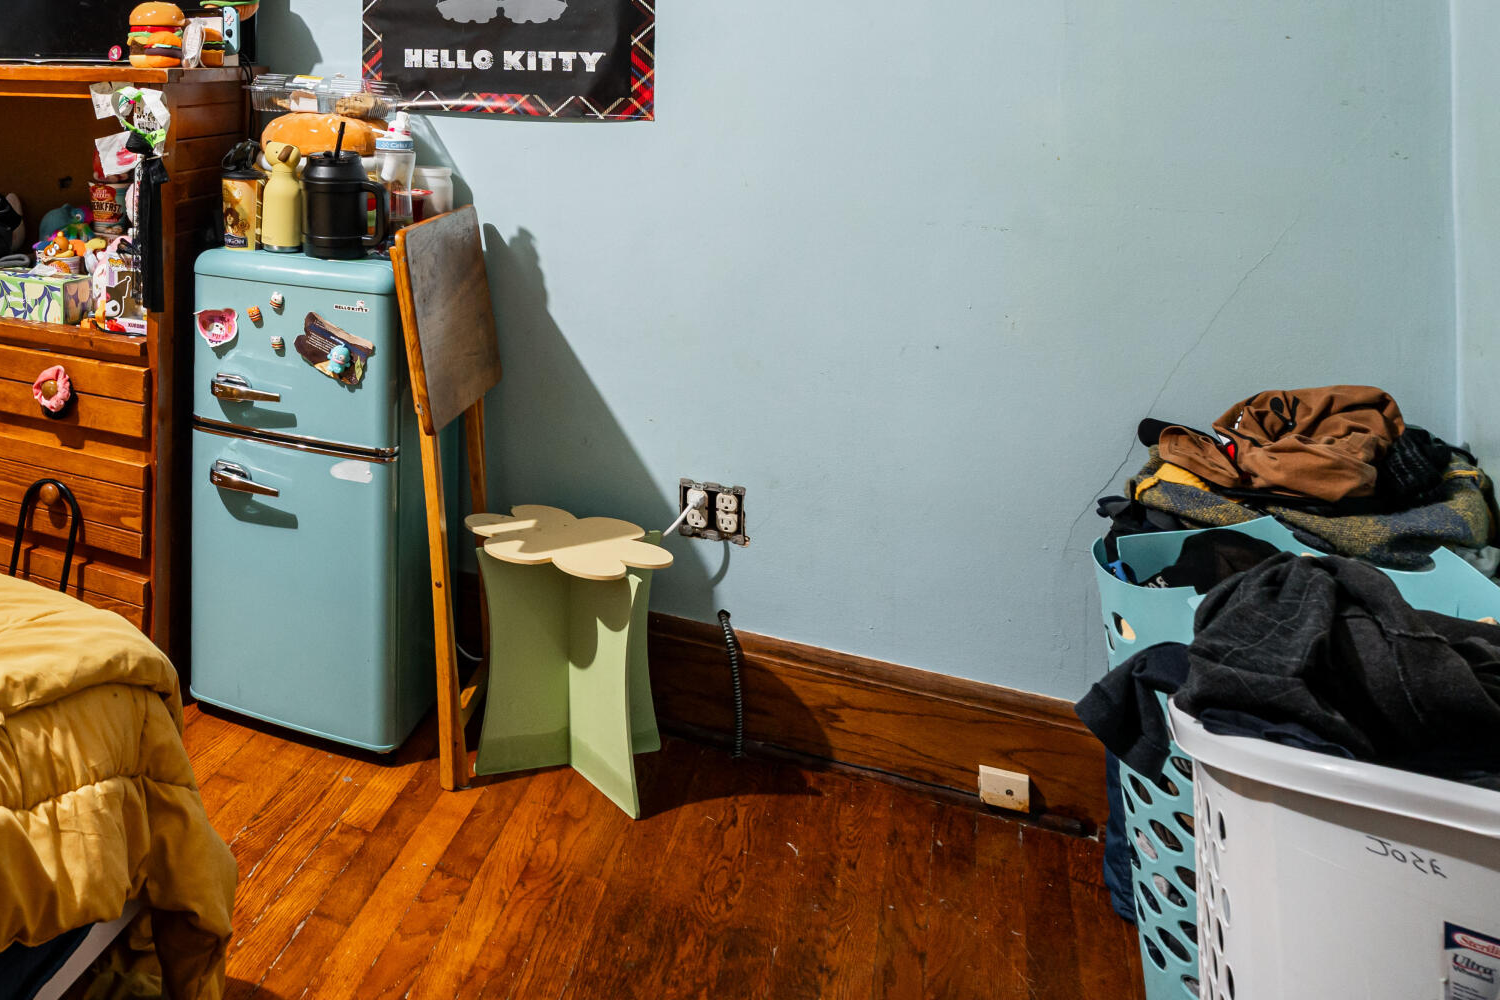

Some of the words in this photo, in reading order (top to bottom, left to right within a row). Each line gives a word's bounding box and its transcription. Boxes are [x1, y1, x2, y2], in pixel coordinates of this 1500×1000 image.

[404, 48, 494, 70] HELLO
[503, 50, 604, 73] KITTY
[1452, 953, 1497, 976] Ultra
